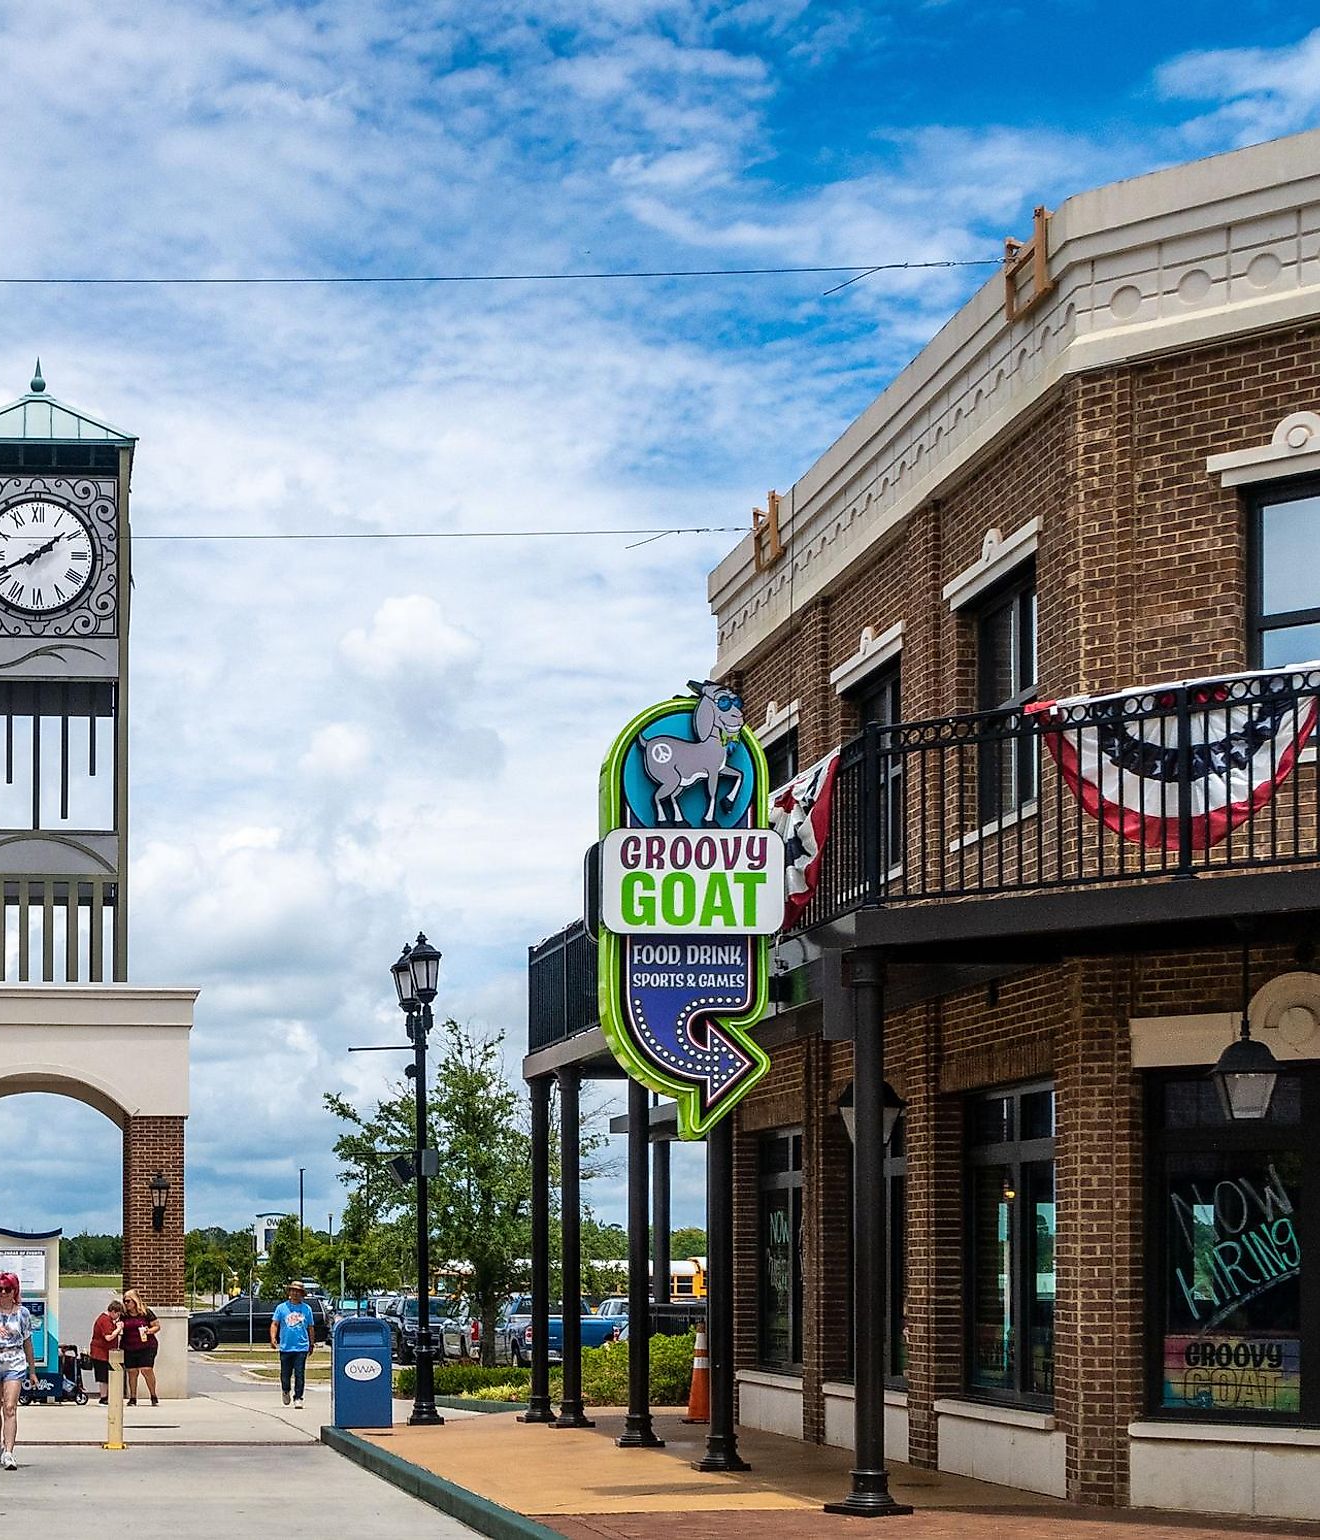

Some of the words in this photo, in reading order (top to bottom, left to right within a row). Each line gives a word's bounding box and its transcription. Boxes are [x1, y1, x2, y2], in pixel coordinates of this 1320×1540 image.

[10, 511, 26, 529] XI
[32, 507, 45, 523] XII
[66, 530, 81, 541] II
[71, 552, 88, 560] III
[8, 580, 25, 602] VII
[32, 588, 43, 606] VI
[54, 584, 66, 600] V
[620, 835, 768, 871] GROOVY
[621, 872, 767, 928] GOAT
[633, 944, 682, 967] FOOD,
[686, 944, 744, 967] DRINK,
[632, 973, 685, 988] SPORTS
[686, 973, 697, 988] &
[699, 973, 745, 988] GAMES
[1171, 1164, 1294, 1251] NOW
[1185, 1343, 1282, 1367] GROOVY
[350, 1364, 376, 1373] OWA
[1183, 1367, 1282, 1407] GOAT
